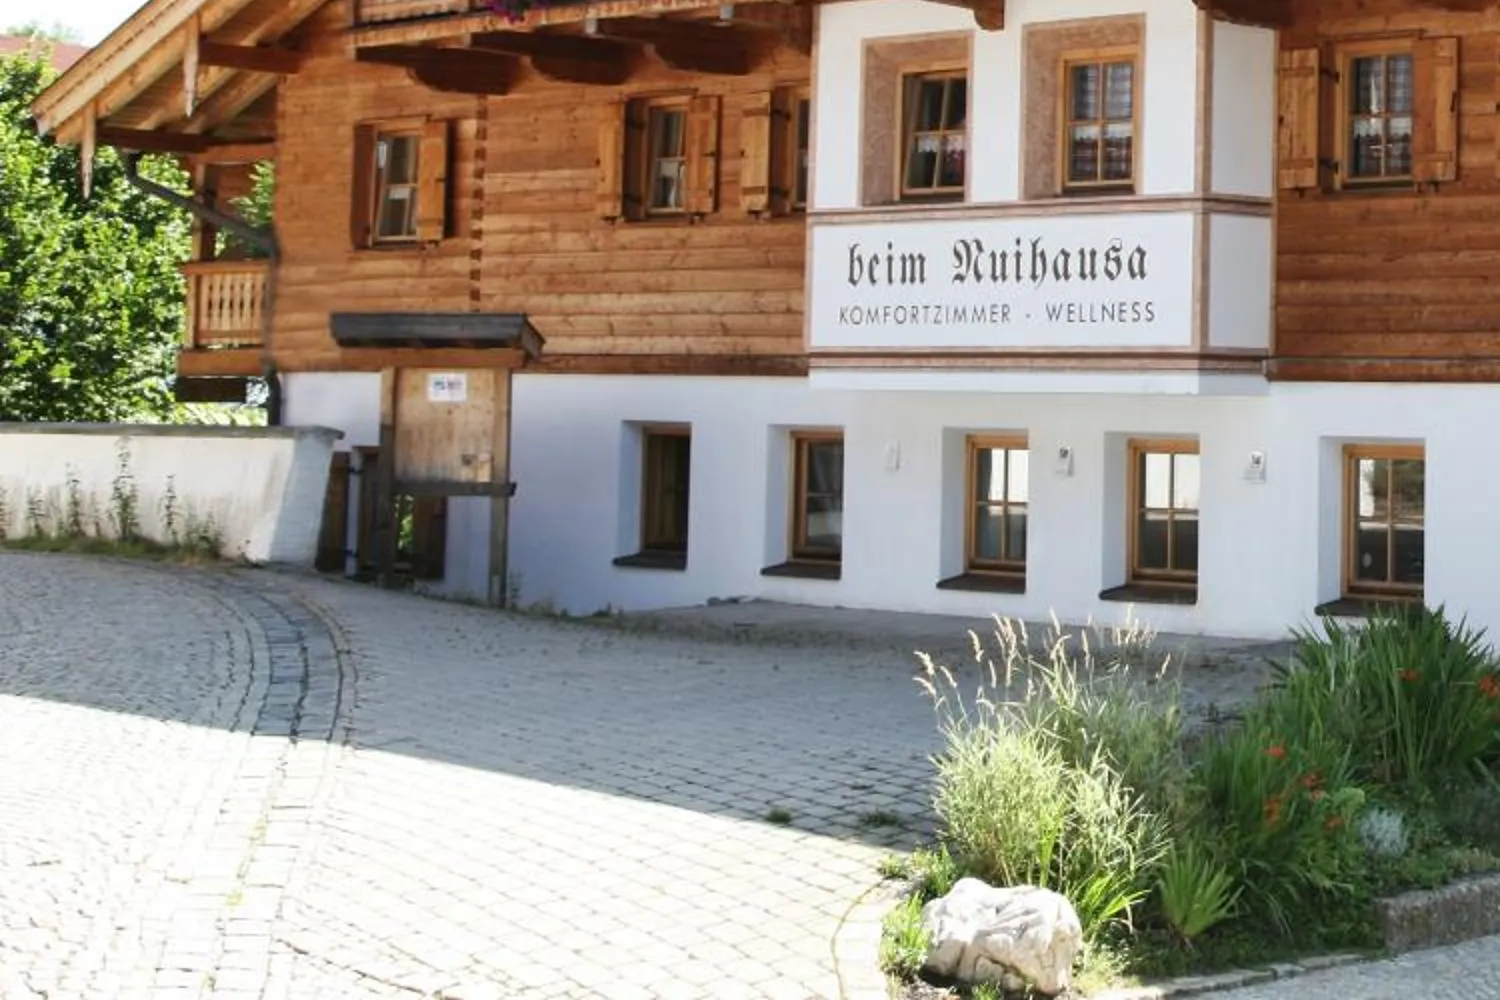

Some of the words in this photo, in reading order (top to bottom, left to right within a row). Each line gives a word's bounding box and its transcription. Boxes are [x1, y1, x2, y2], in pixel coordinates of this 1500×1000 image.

[849, 241, 926, 287] beim
[839, 304, 1012, 325] KOMFORTZIMMER
[1046, 302, 1156, 323] WELLNESS
